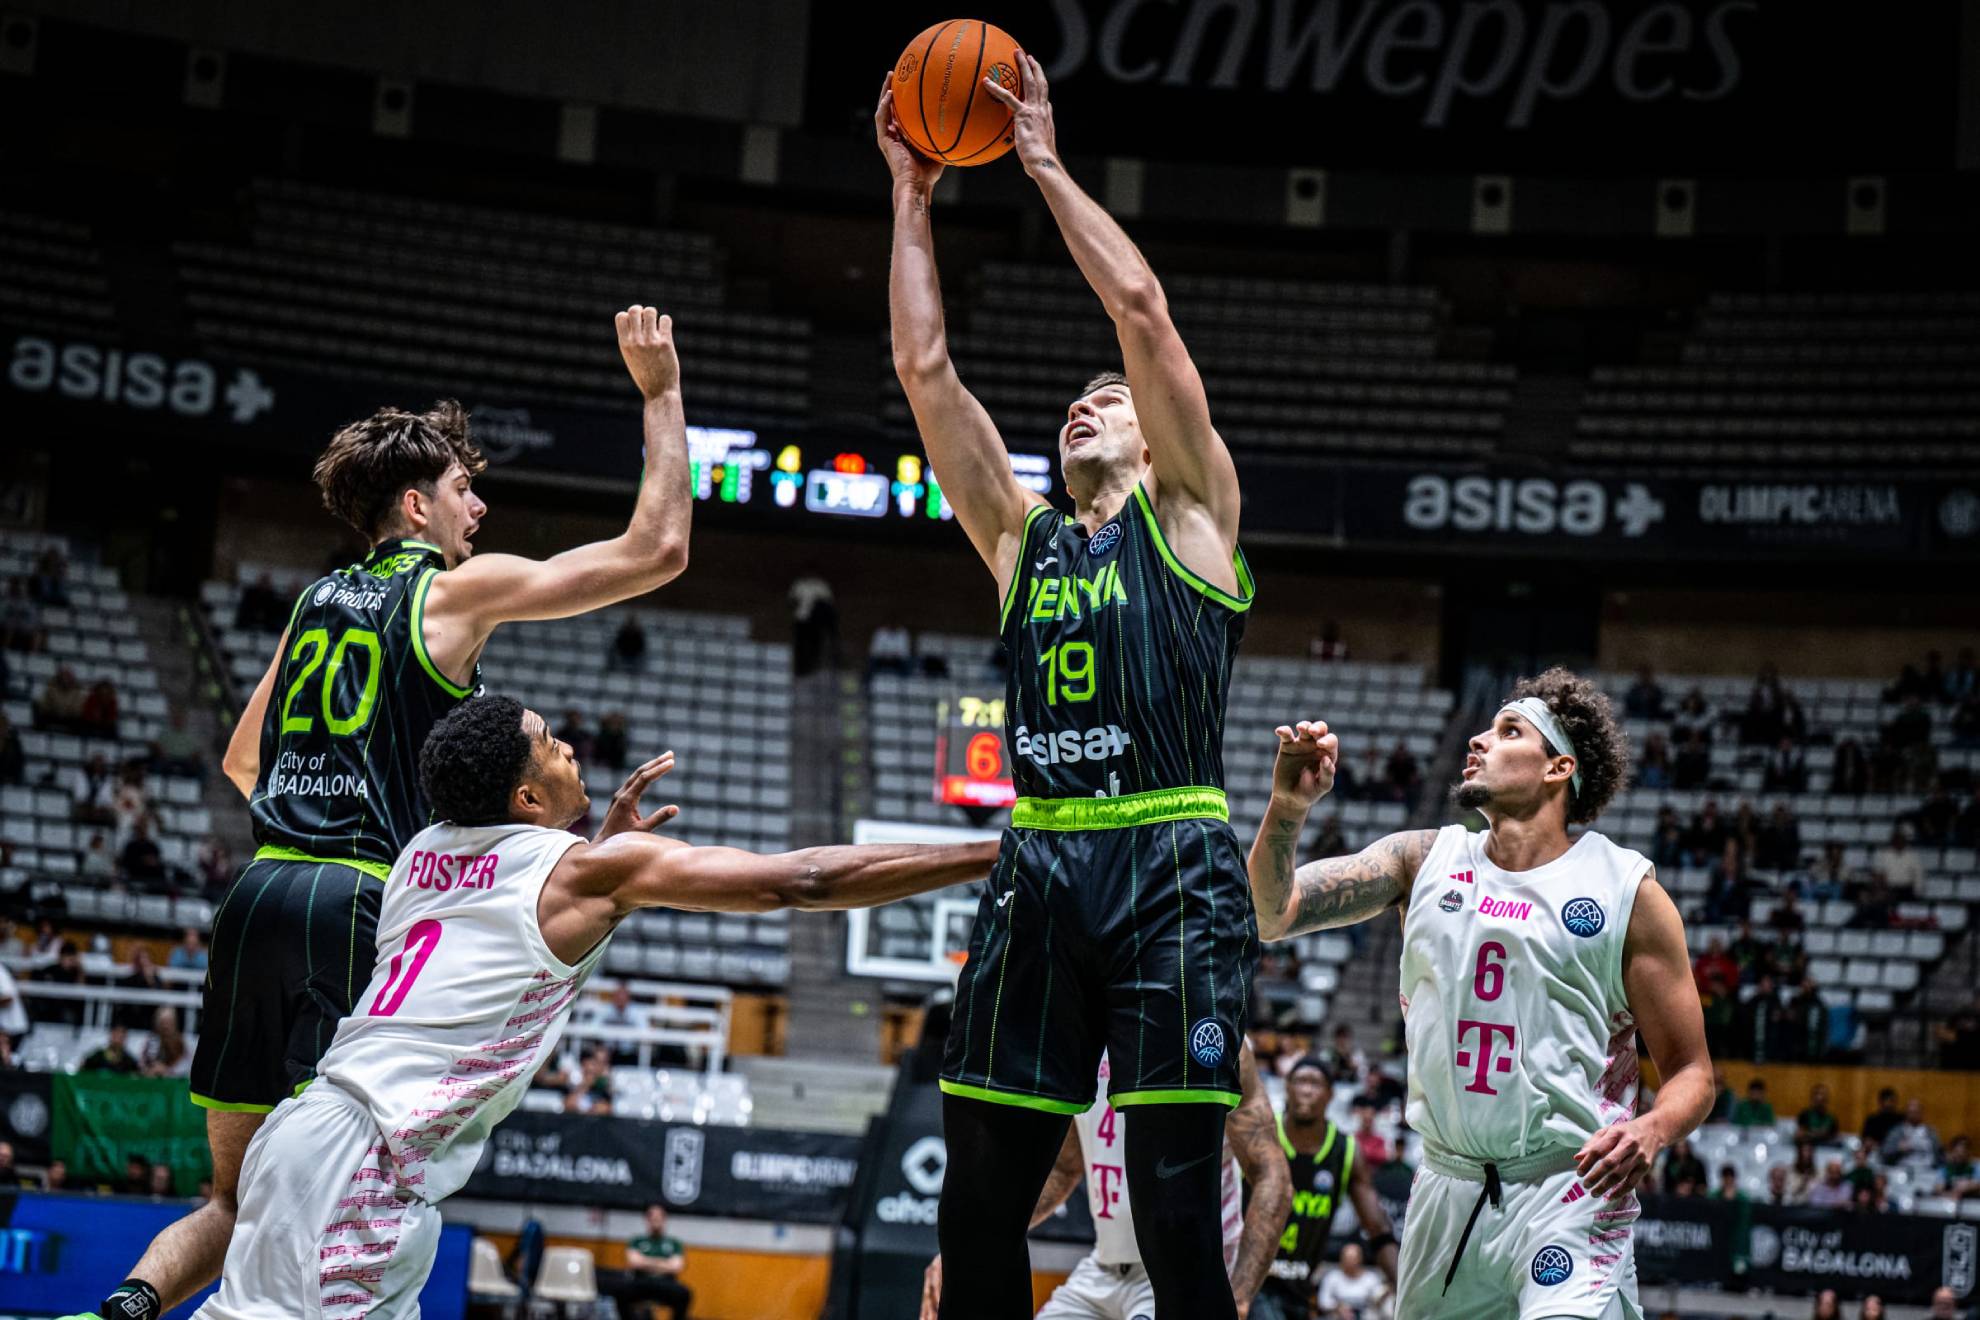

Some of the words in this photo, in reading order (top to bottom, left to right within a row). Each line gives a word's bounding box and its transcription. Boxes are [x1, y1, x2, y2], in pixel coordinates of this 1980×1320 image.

[9, 335, 216, 415] asisa
[1403, 474, 1607, 536] asisa
[1023, 560, 1129, 627] PENYA
[281, 628, 382, 736] 20
[1039, 641, 1097, 706] 19
[280, 751, 305, 774] City
[308, 753, 326, 770] of
[966, 732, 1002, 780] 6
[277, 774, 368, 799] BADALONA
[407, 851, 499, 892] FOSTER
[1478, 896, 1533, 921] BONN
[368, 919, 442, 1017] 0
[1474, 941, 1506, 1001] 6
[1097, 1105, 1116, 1147] 4
[494, 1149, 633, 1186] BADALONA
[1292, 1190, 1331, 1219] NYA
[1782, 1246, 1912, 1280] BADALONA
